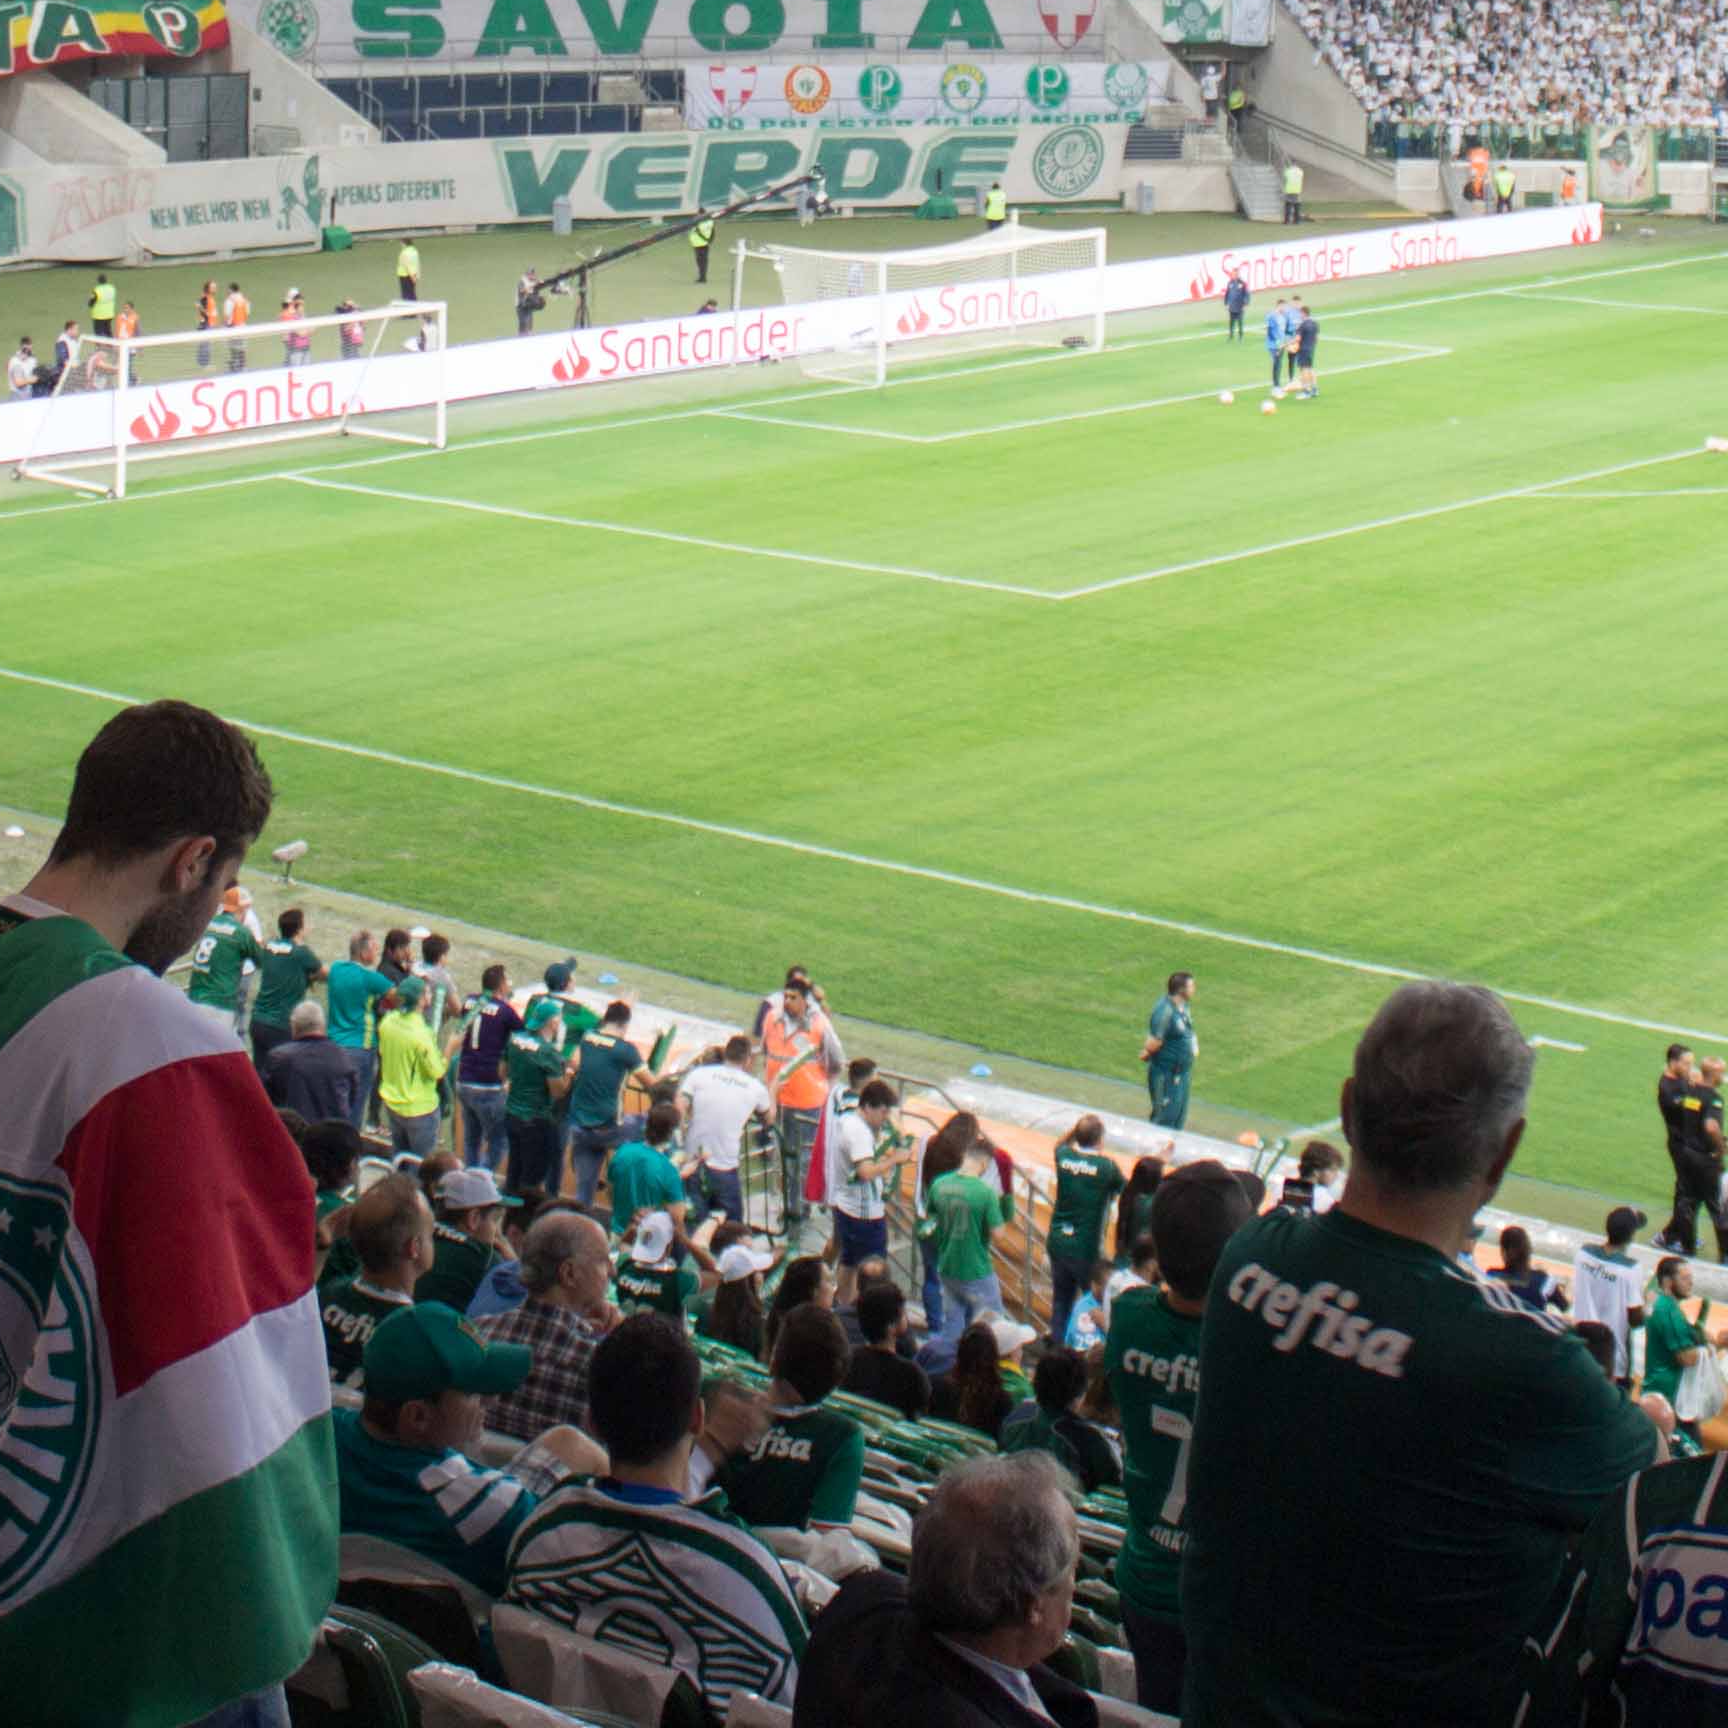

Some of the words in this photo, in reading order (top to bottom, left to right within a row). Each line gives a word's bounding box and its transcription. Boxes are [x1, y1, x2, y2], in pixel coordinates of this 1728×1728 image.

[386, 178, 456, 205] DIFERENTE
[494, 128, 1020, 217] VERDE
[150, 206, 181, 229] NEM
[184, 200, 239, 227] MELHOR
[242, 196, 271, 220] NEM
[1220, 243, 1355, 298] Santander
[599, 312, 805, 377] Santander
[322, 1304, 375, 1345] crefi
[1227, 1261, 1416, 1380] crefisa
[1122, 1348, 1200, 1393] crefi
